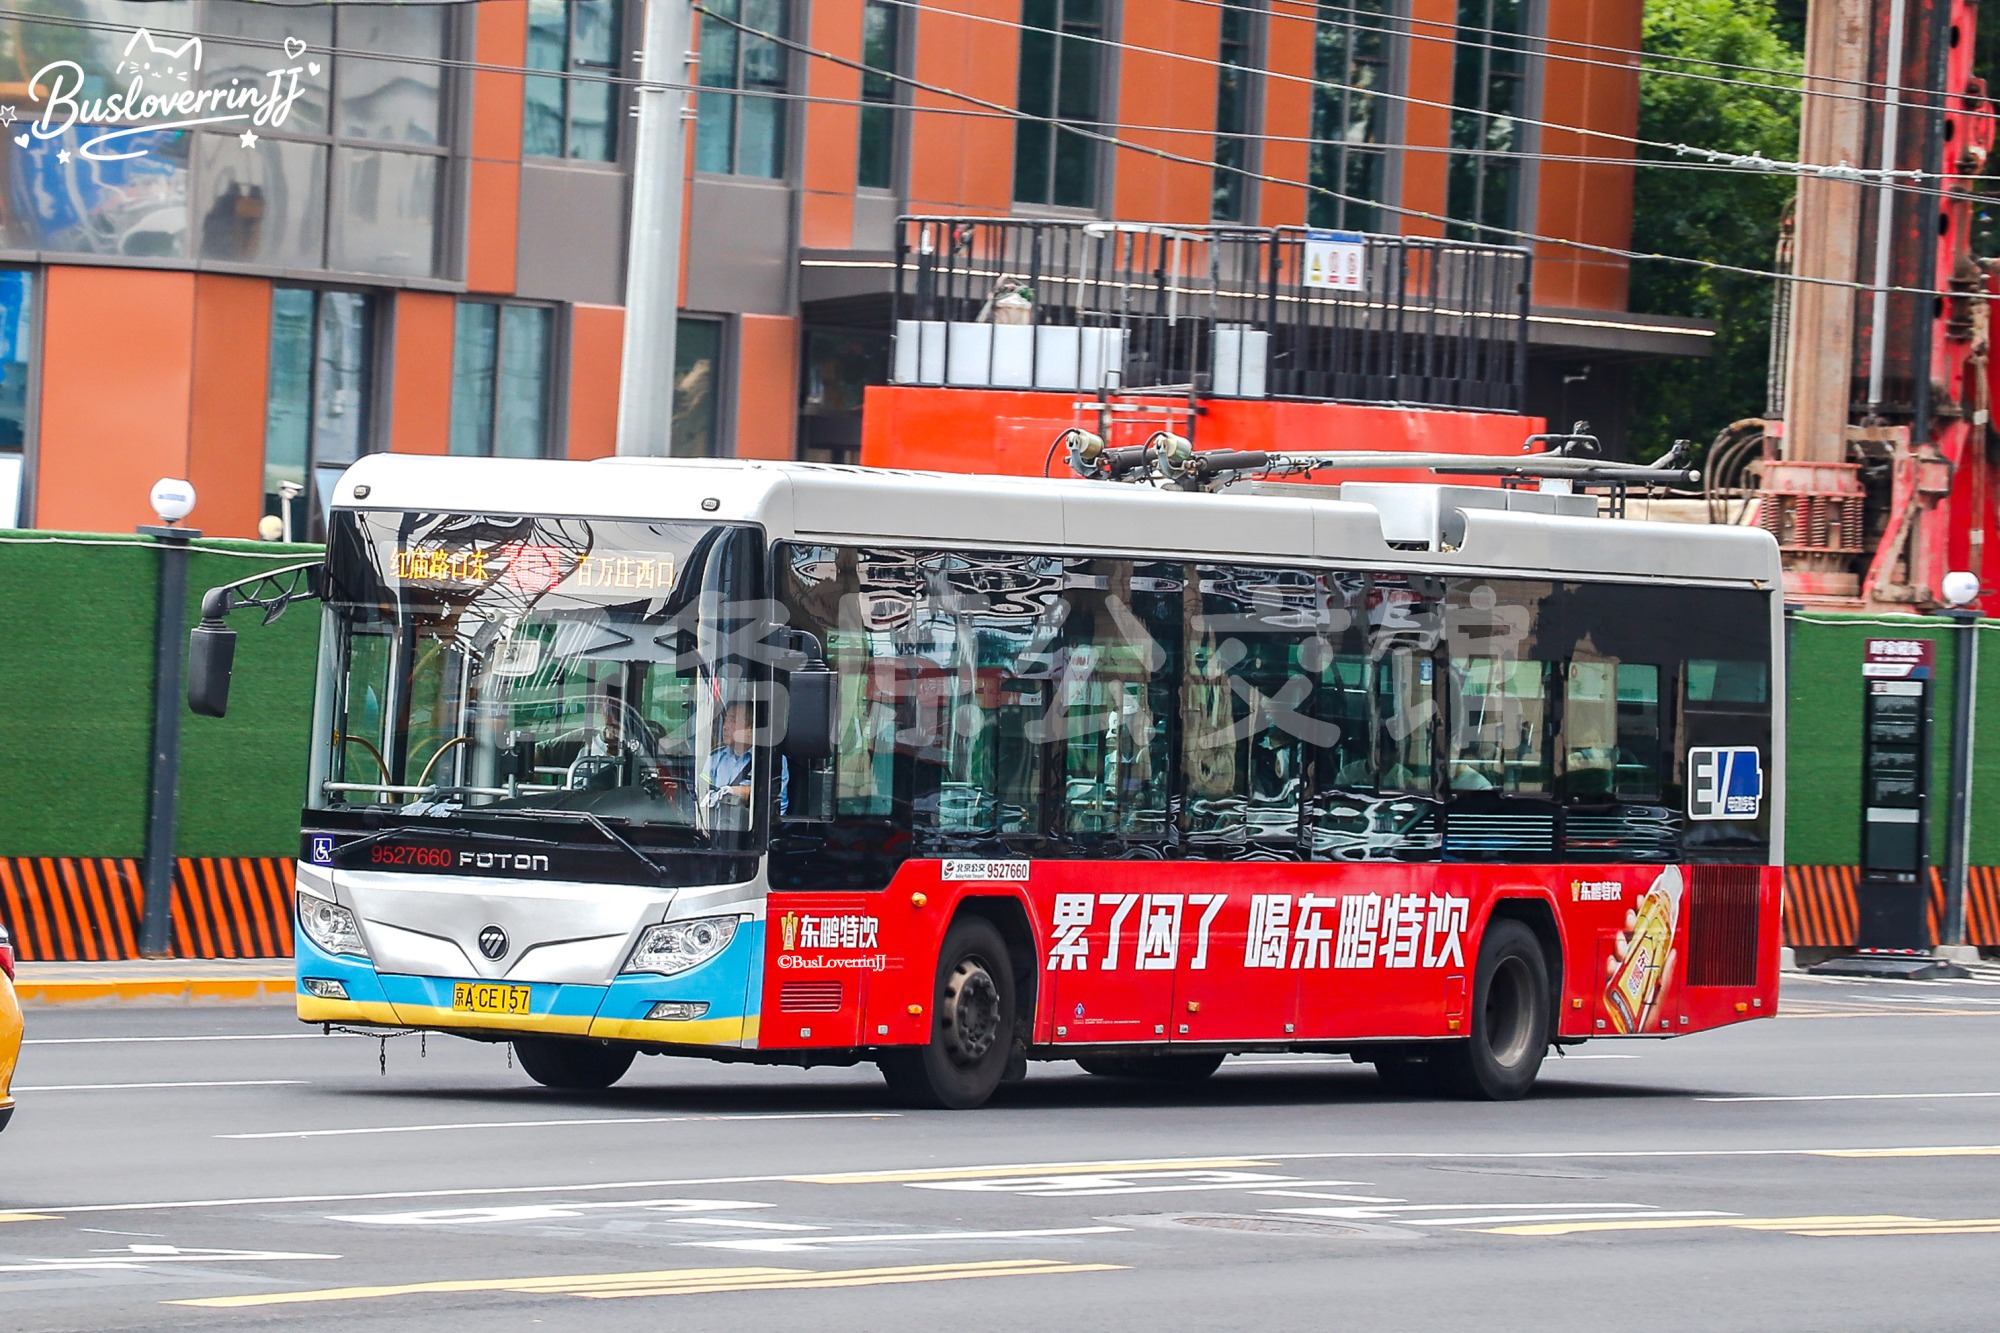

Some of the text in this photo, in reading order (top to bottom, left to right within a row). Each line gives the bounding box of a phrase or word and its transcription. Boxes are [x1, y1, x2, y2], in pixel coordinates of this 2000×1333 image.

[576, 554, 675, 589] 百万庄西口
[371, 845, 452, 867] 9527660
[459, 851, 549, 872] FOTON
[956, 863, 986, 873] 北京公交
[987, 863, 1028, 879] 9527660
[1580, 881, 1622, 901] 东鹏特饮
[800, 914, 879, 949] 东鹏特饮
[1046, 891, 1470, 971] 累了困了 喝东鹏特饮
